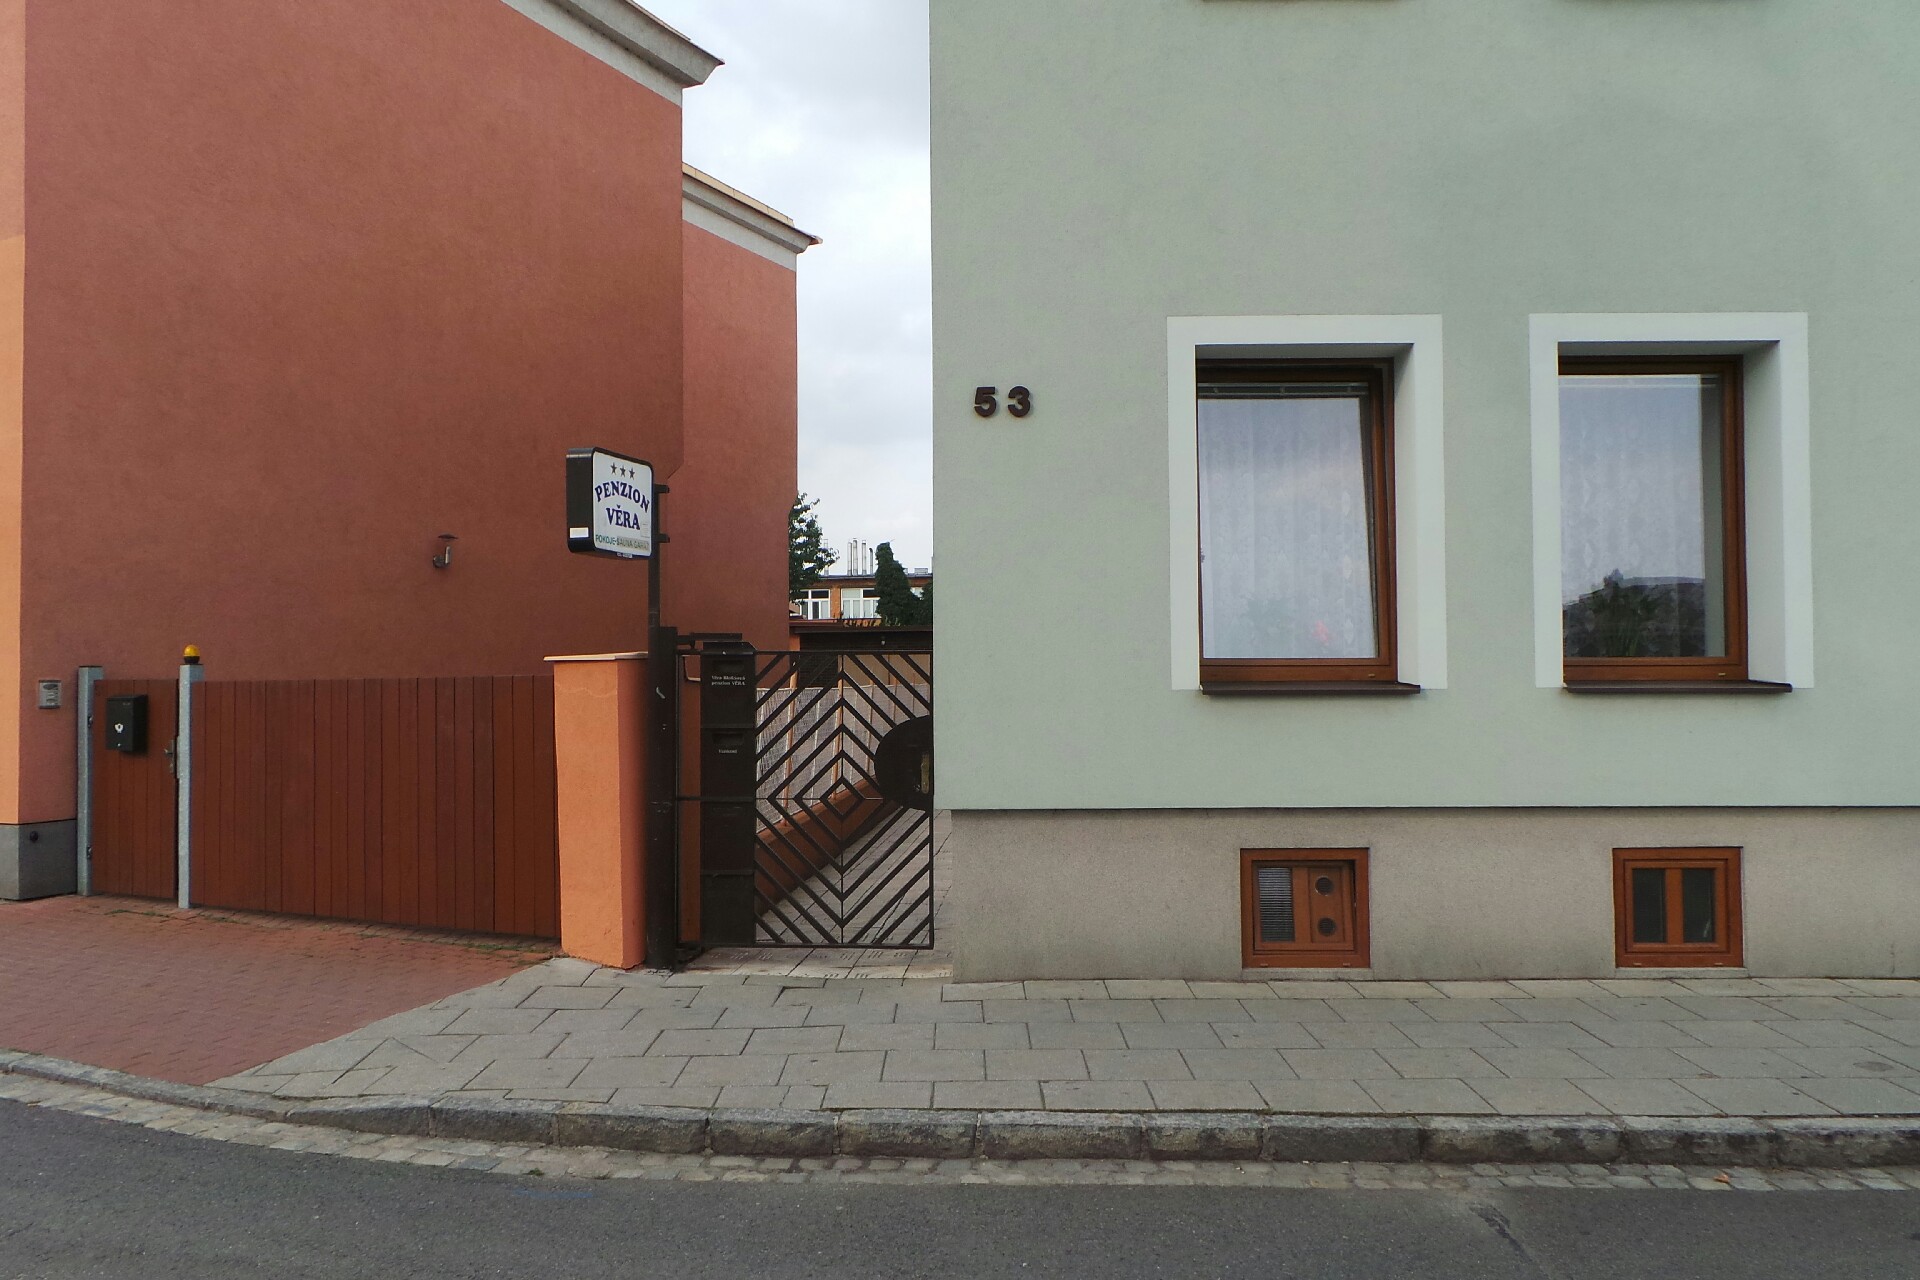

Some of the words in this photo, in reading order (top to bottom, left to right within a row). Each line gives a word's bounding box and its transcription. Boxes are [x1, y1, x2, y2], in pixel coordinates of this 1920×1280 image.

[974, 385, 1031, 418] 53
[594, 480, 650, 514] PENZION
[606, 504, 641, 531] VĚRA
